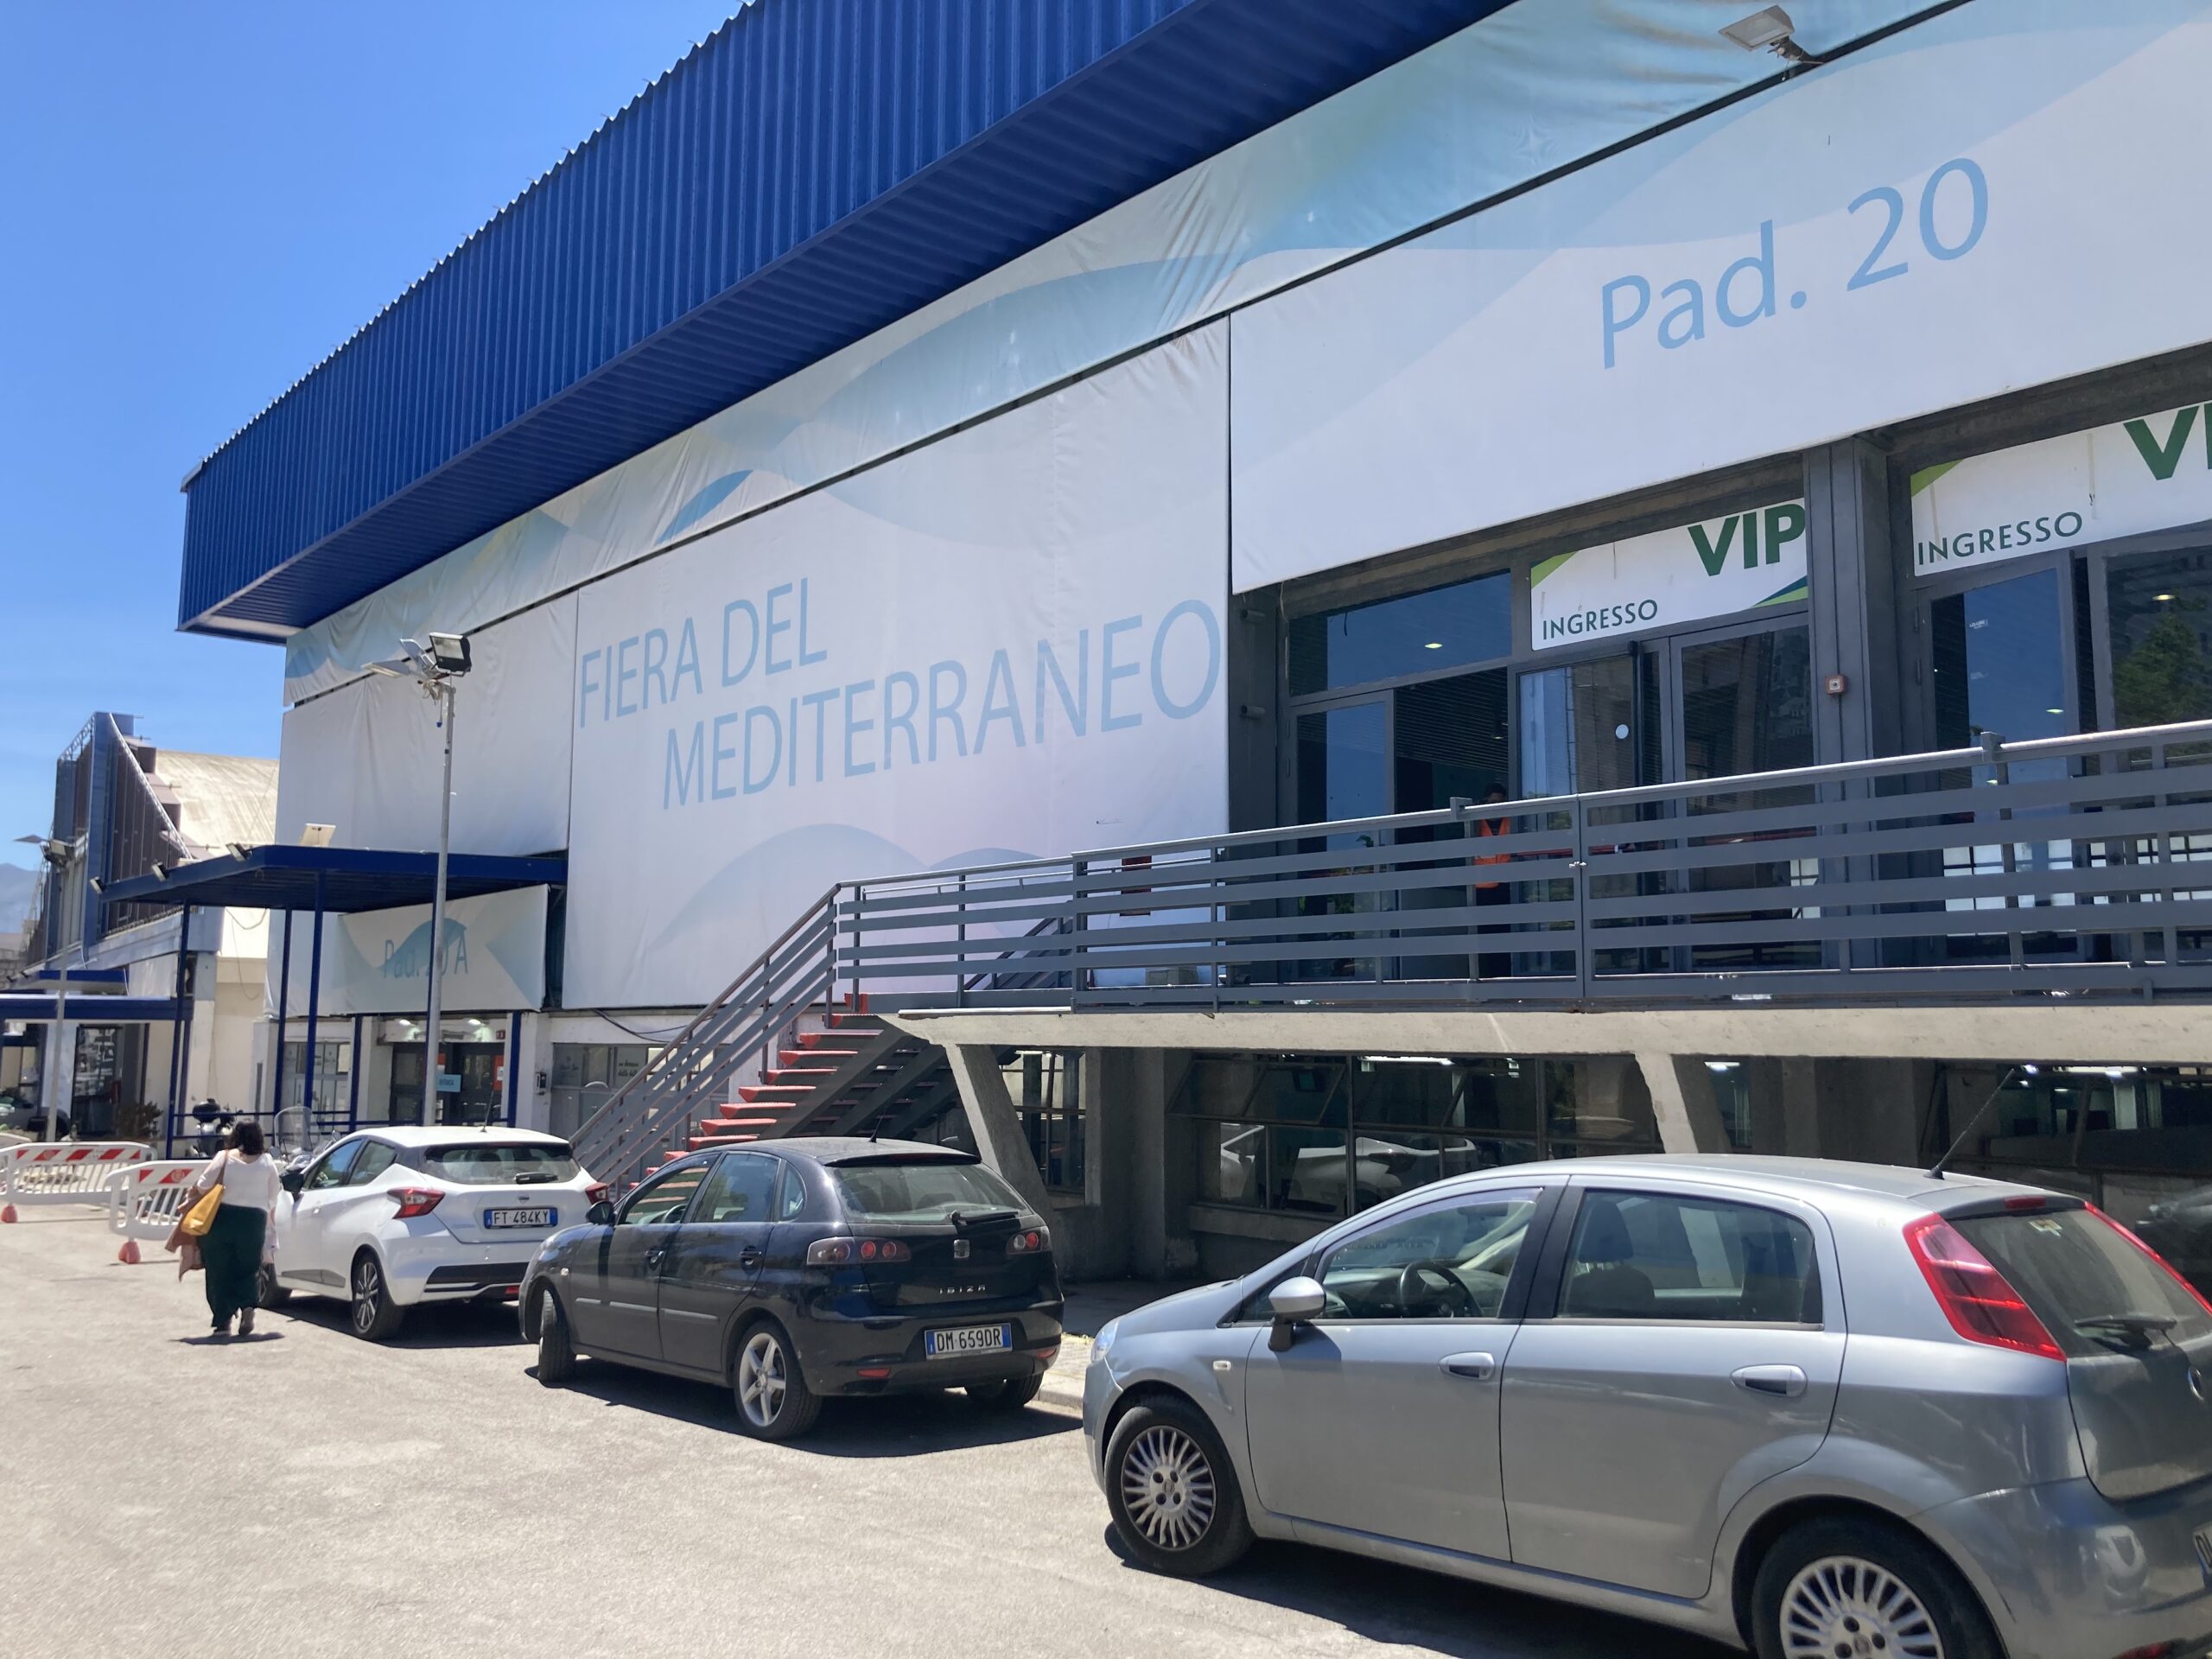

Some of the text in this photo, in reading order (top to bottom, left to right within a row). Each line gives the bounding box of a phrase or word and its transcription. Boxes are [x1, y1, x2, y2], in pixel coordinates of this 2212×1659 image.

[1602, 157, 1989, 370] Pad. 20
[1688, 504, 1806, 576] VIP
[1917, 512, 2083, 566] INGRESSO
[1542, 599, 1658, 640] INGRESSO
[580, 577, 828, 728] FIERA DEL
[663, 599, 1221, 810] MEDITERRANEO
[493, 1211, 549, 1224] FT 484KY
[937, 1328, 1001, 1351] DM 659DR
